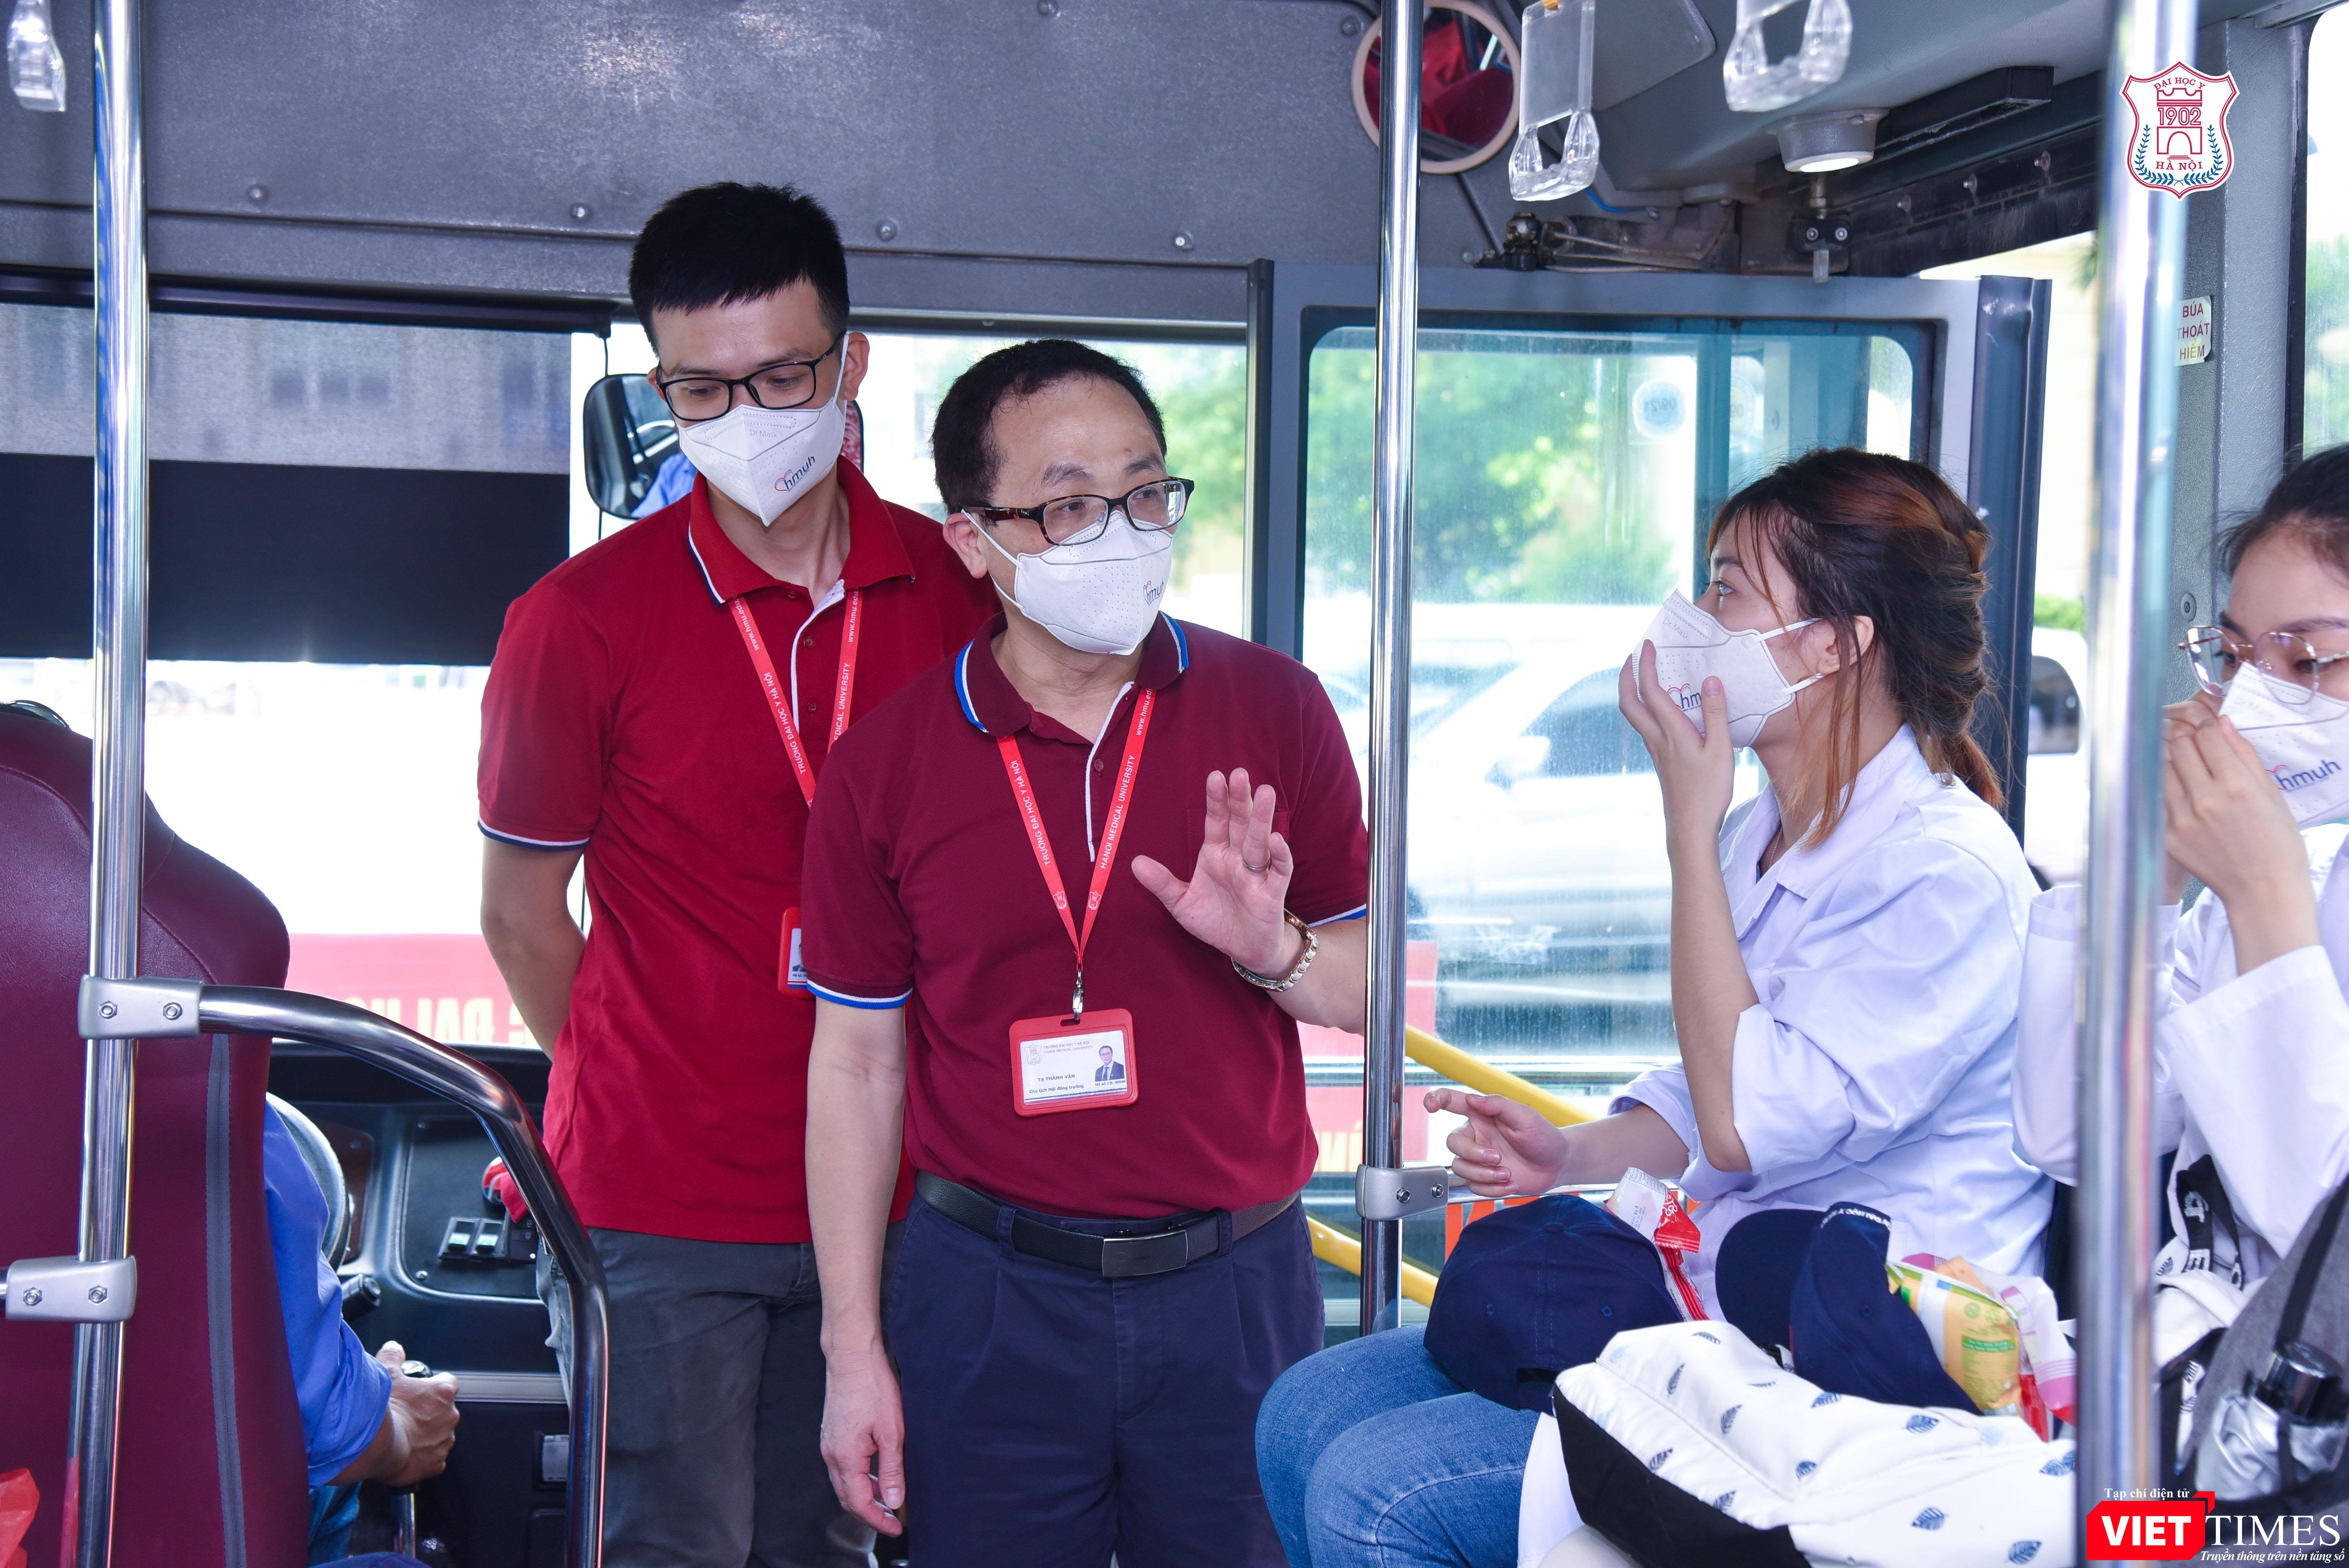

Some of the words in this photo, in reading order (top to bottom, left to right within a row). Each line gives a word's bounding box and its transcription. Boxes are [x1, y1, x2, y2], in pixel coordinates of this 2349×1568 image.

[2182, 301, 2204, 318] BÚA
[2176, 321, 2210, 340] THOÁT
[2180, 340, 2205, 360] HIỂM
[838, 663, 850, 709] UNIVERSITY
[834, 712, 844, 741] EDICAL
[1014, 775, 1025, 788] HÀ
[1023, 796, 1035, 814] HỌC
[1100, 842, 1113, 869] HANOI
[1107, 804, 1123, 841] MEDICAL
[1117, 754, 1135, 802] UNIVERSITY
